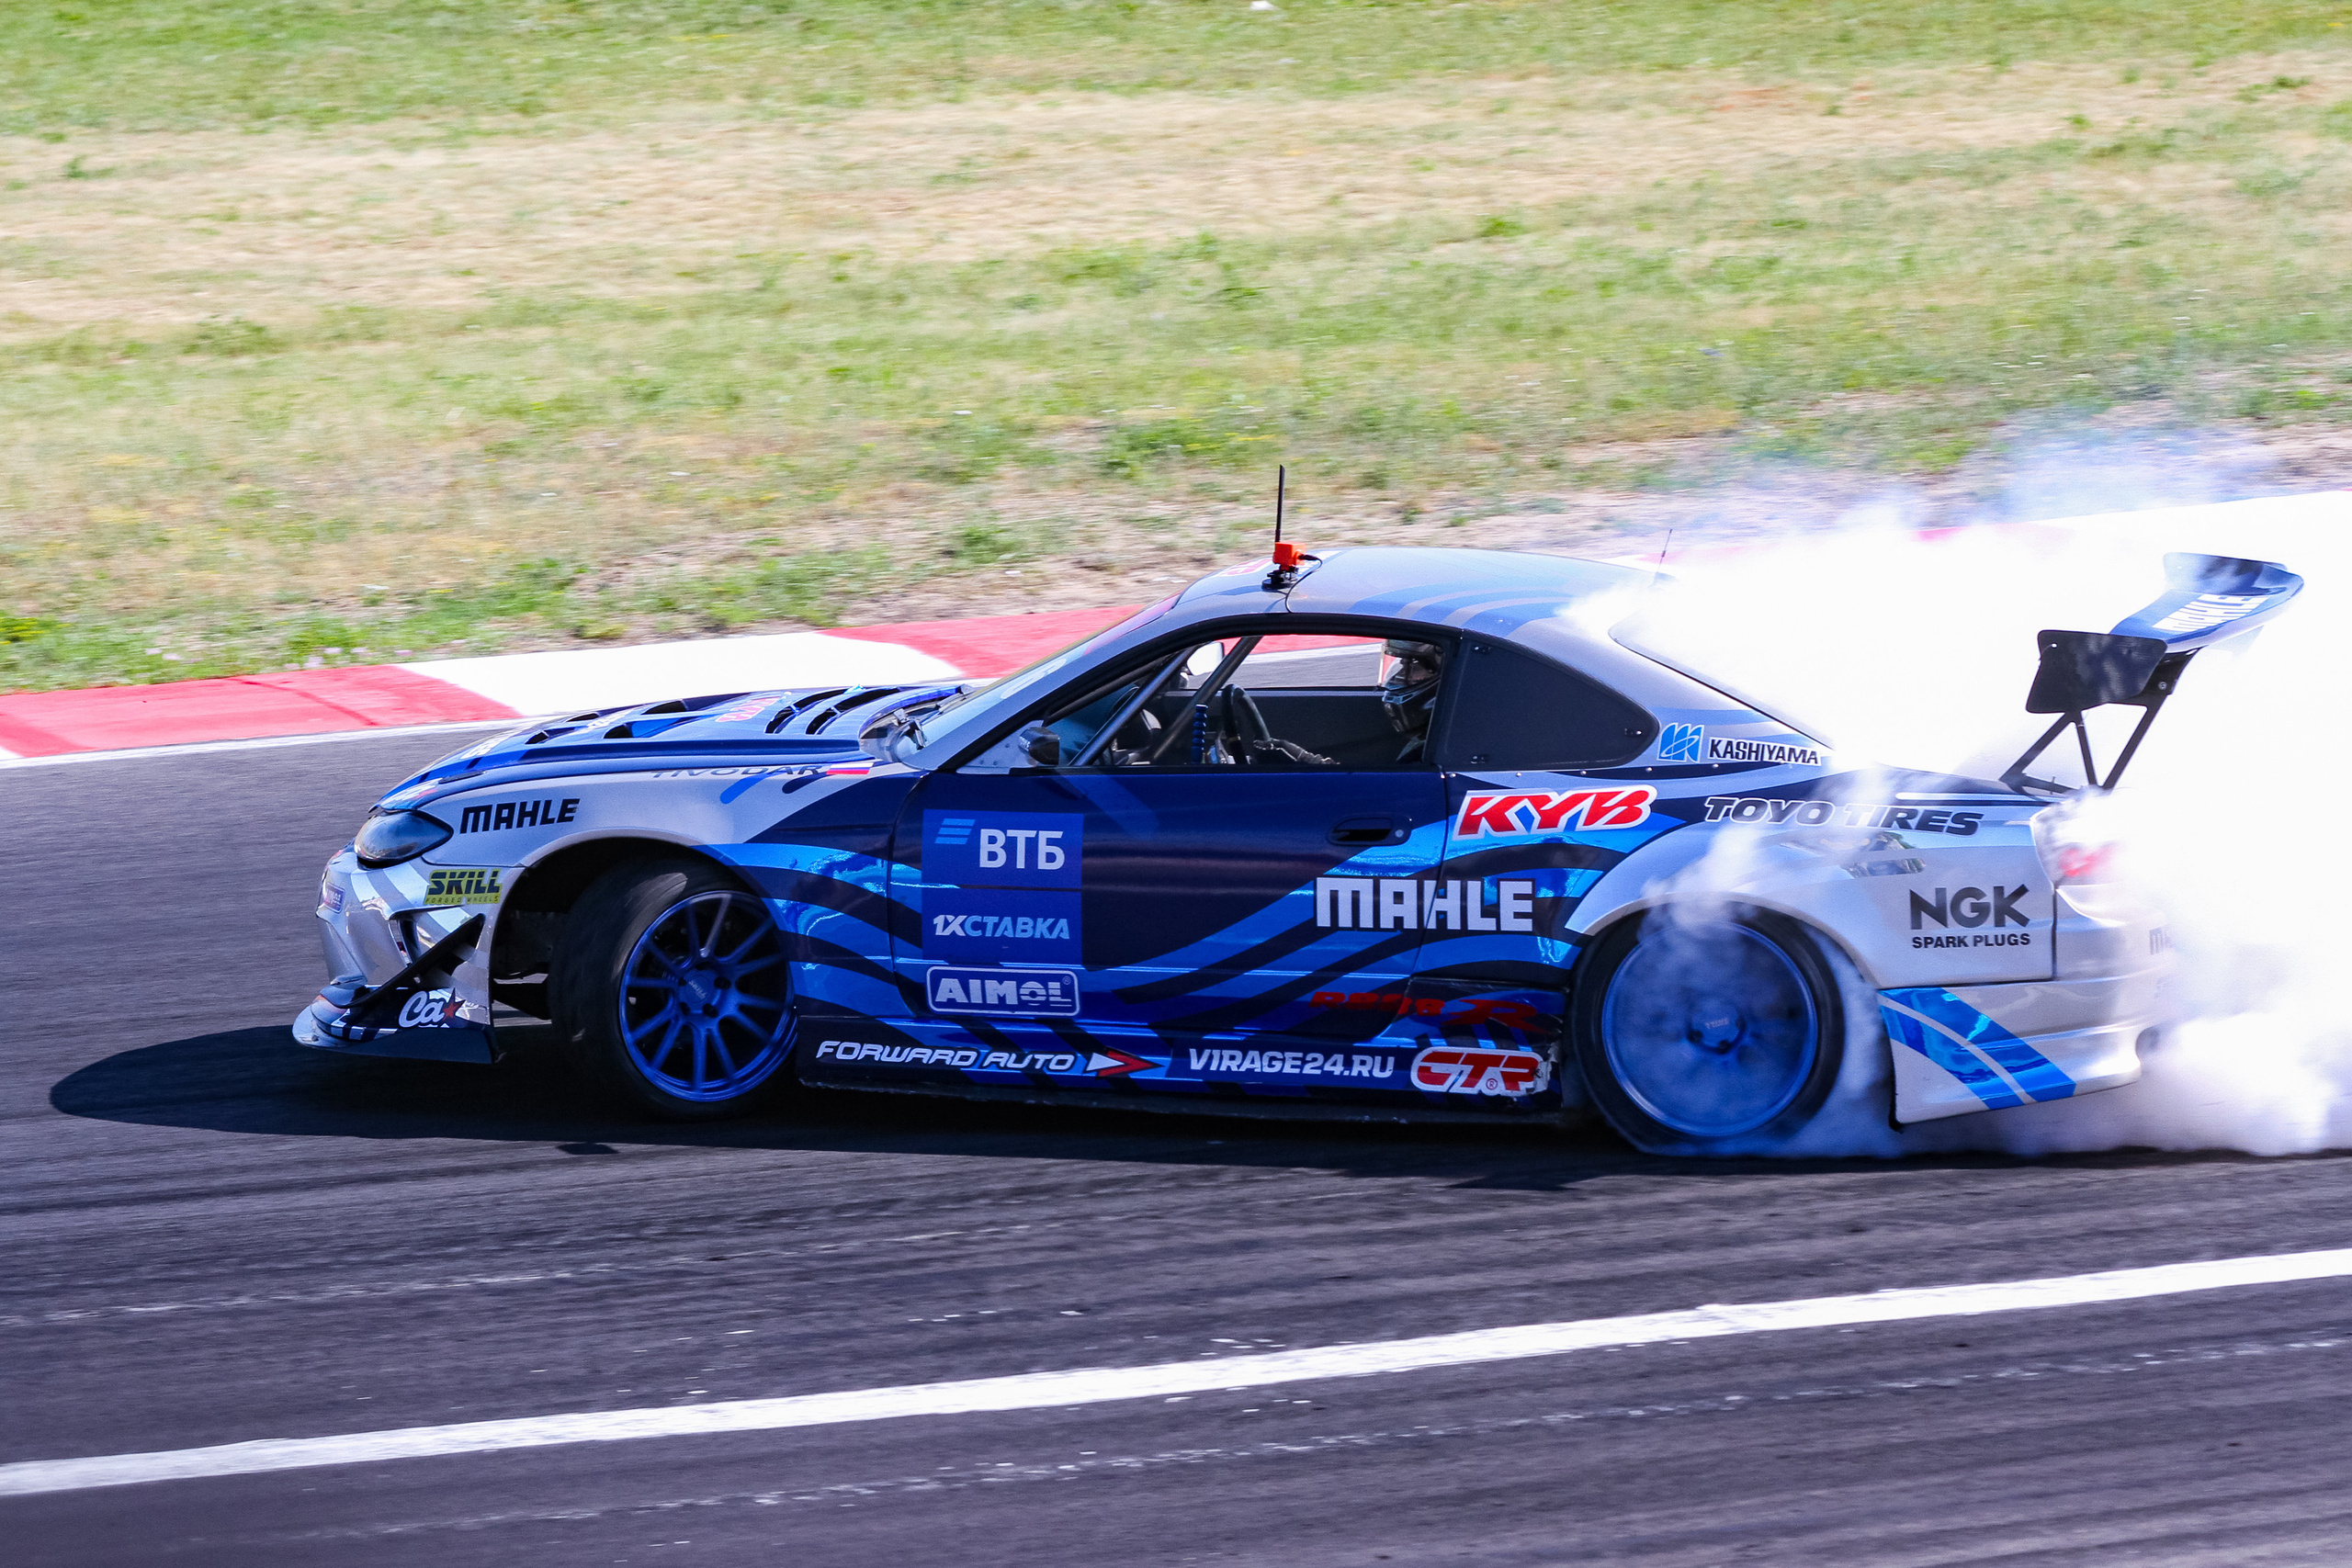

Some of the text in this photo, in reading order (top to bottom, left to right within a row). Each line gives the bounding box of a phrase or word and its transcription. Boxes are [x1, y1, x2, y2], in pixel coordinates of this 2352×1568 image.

[1709, 739, 1819, 765] KASHIYAMA
[459, 798, 581, 834] MAHLE
[1456, 787, 1654, 838] KYB
[1705, 796, 1984, 836] TOYO TIRES
[979, 829, 1065, 870] ВТБ
[428, 870, 500, 896] SKILL
[1316, 877, 1533, 931] MAHLE
[1909, 884, 2030, 930] NGK
[1912, 933, 2030, 949] SPARK PLUGS
[934, 977, 1073, 1007] AIMOL
[816, 1041, 1078, 1071] FORWARD AUTO
[1189, 1047, 1396, 1078] VIRAGE24.RU
[1416, 1050, 1541, 1091] CTR
